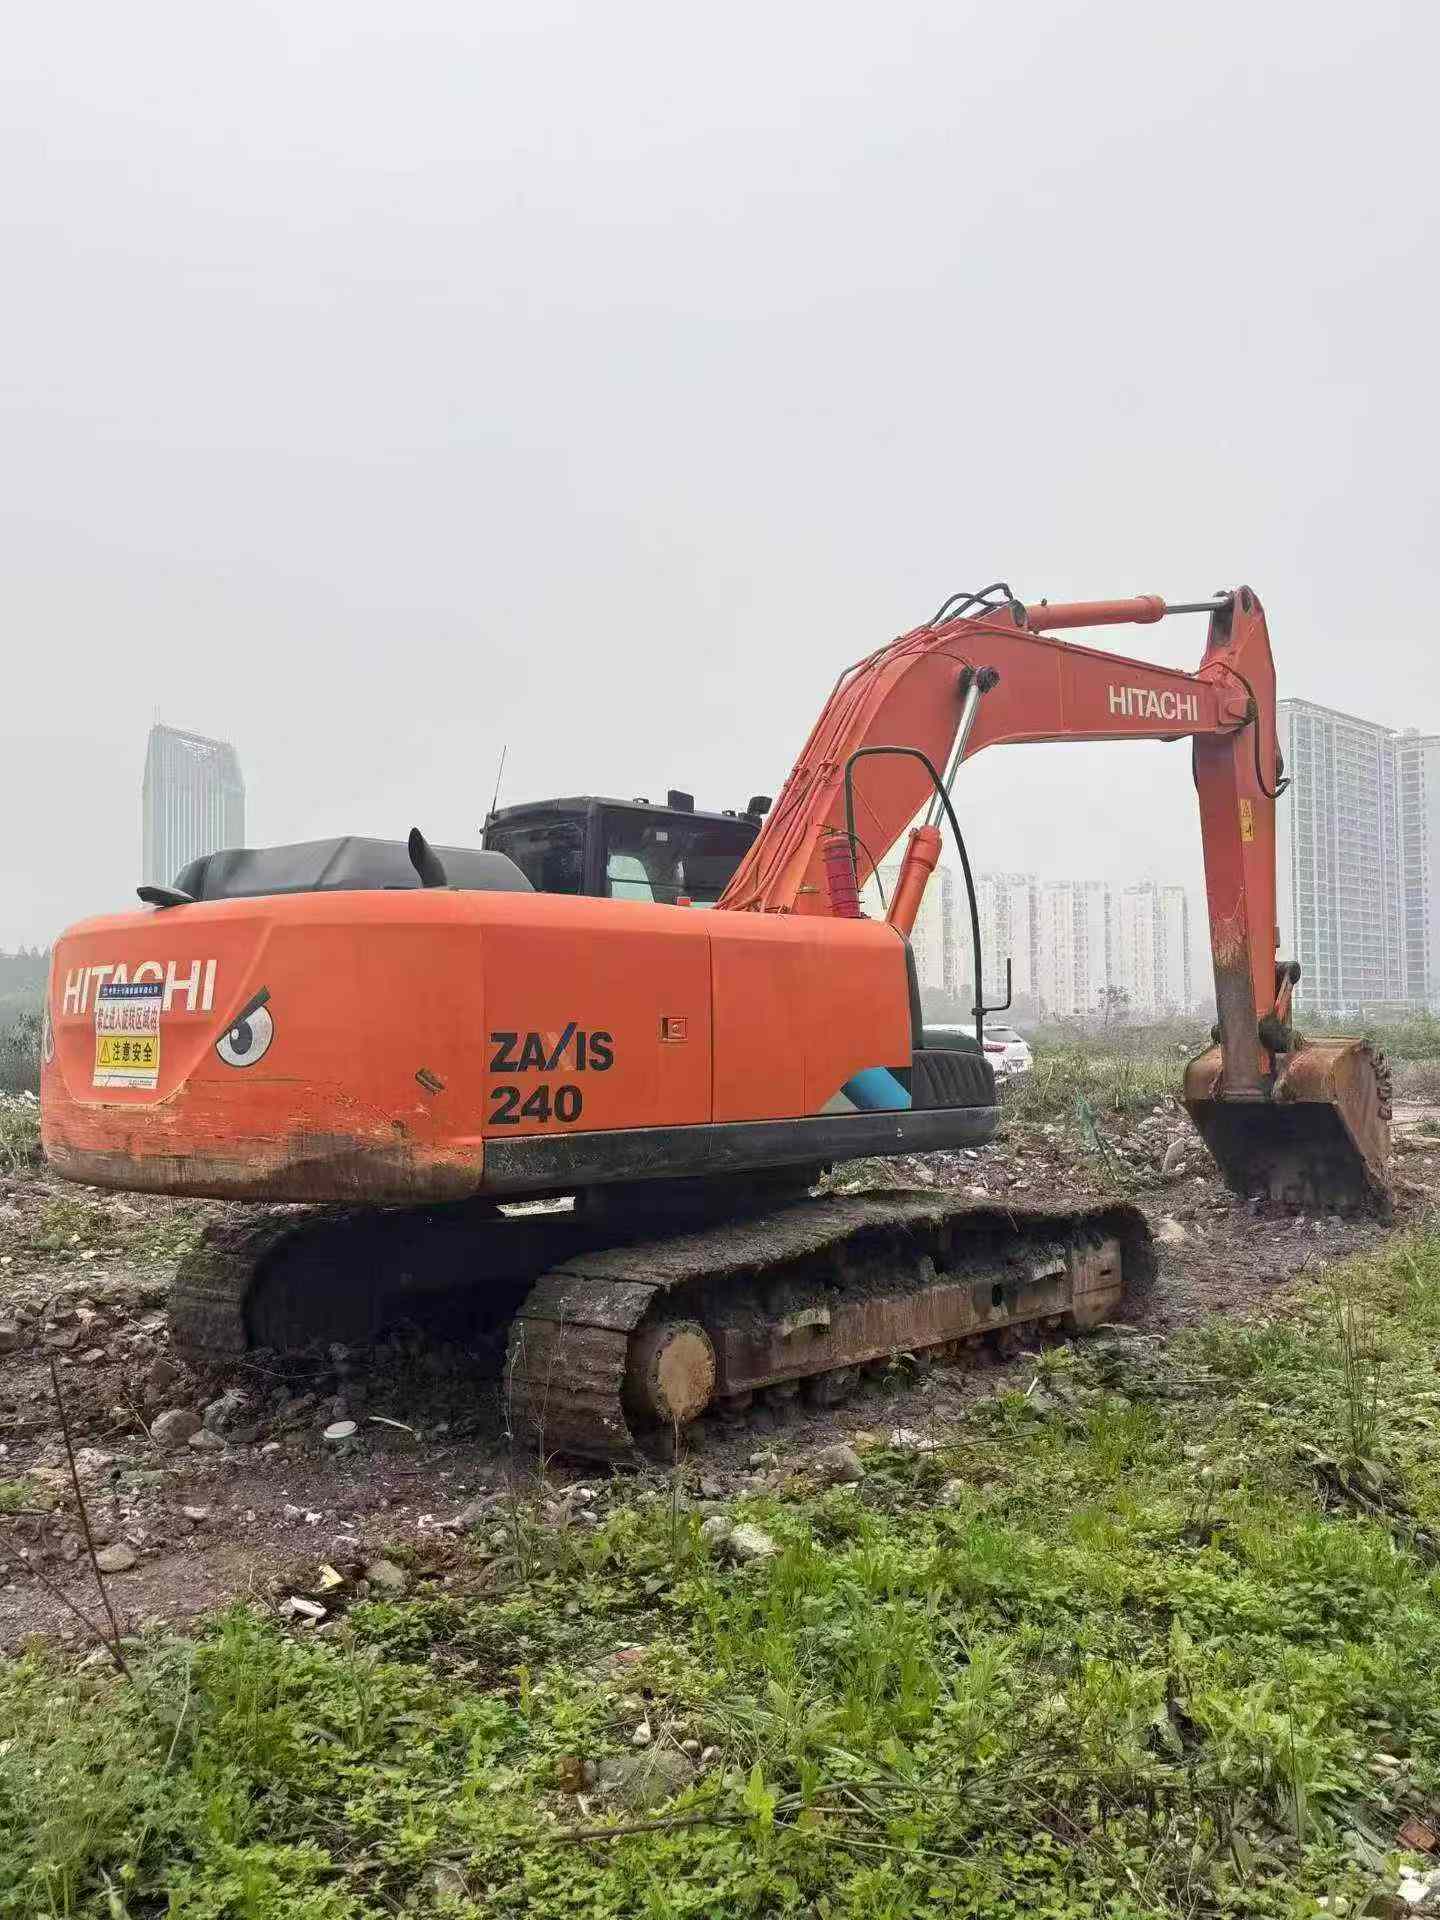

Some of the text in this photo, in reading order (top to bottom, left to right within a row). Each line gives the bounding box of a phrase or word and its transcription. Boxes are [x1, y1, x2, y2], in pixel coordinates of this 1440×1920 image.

[1109, 685, 1198, 721] HITACHI
[112, 1041, 153, 1063] 注意安全
[490, 1022, 614, 1072] ZAXIS
[489, 1084, 583, 1125] 240
